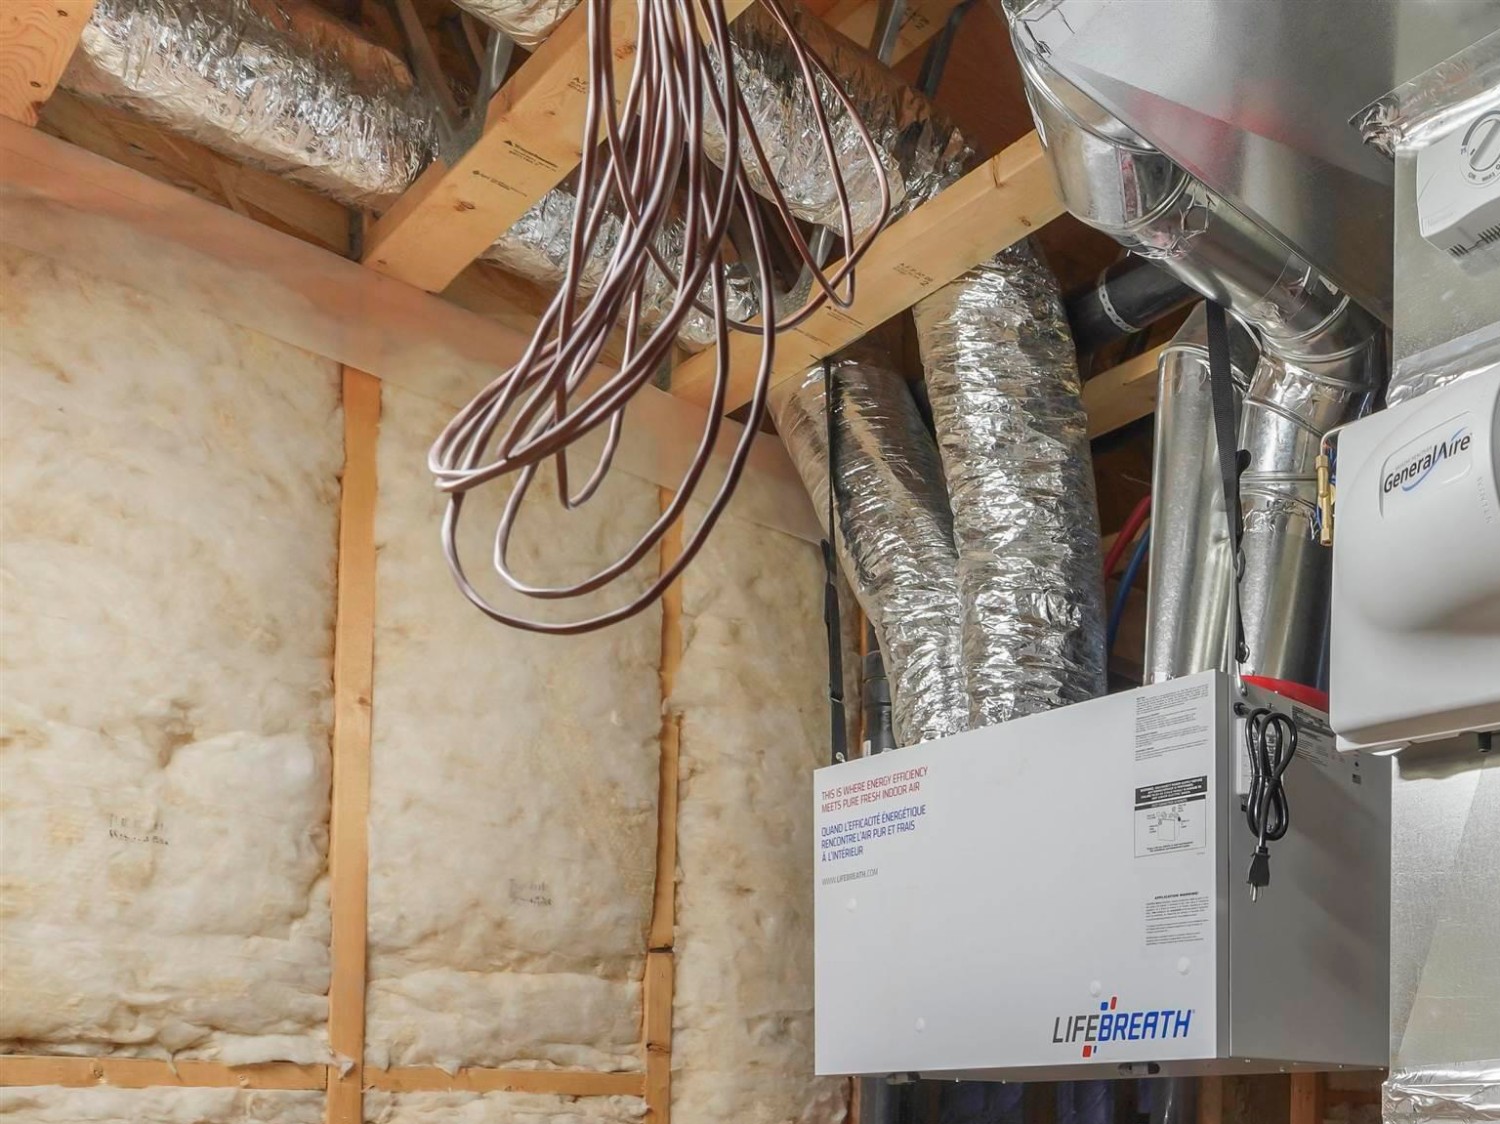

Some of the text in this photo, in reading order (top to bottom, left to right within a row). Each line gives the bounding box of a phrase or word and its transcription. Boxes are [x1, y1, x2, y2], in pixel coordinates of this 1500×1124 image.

[822, 767, 929, 800] THIS IS WHERE ENERGY EFFICIENCY
[822, 782, 921, 814] MEETS PURE FRESH INDOOR AIR
[821, 804, 926, 837] QUAND L'EFFICACITÉ ÉNERGÉTIQUE
[821, 820, 916, 849] RENCONTRE L'AIR PUR ET FRAIS
[828, 845, 864, 862] L'INTÉRIEUR
[822, 868, 879, 886] WWW.LIFEBREATH.COM
[1052, 1009, 1192, 1043] LIFEBREATH
